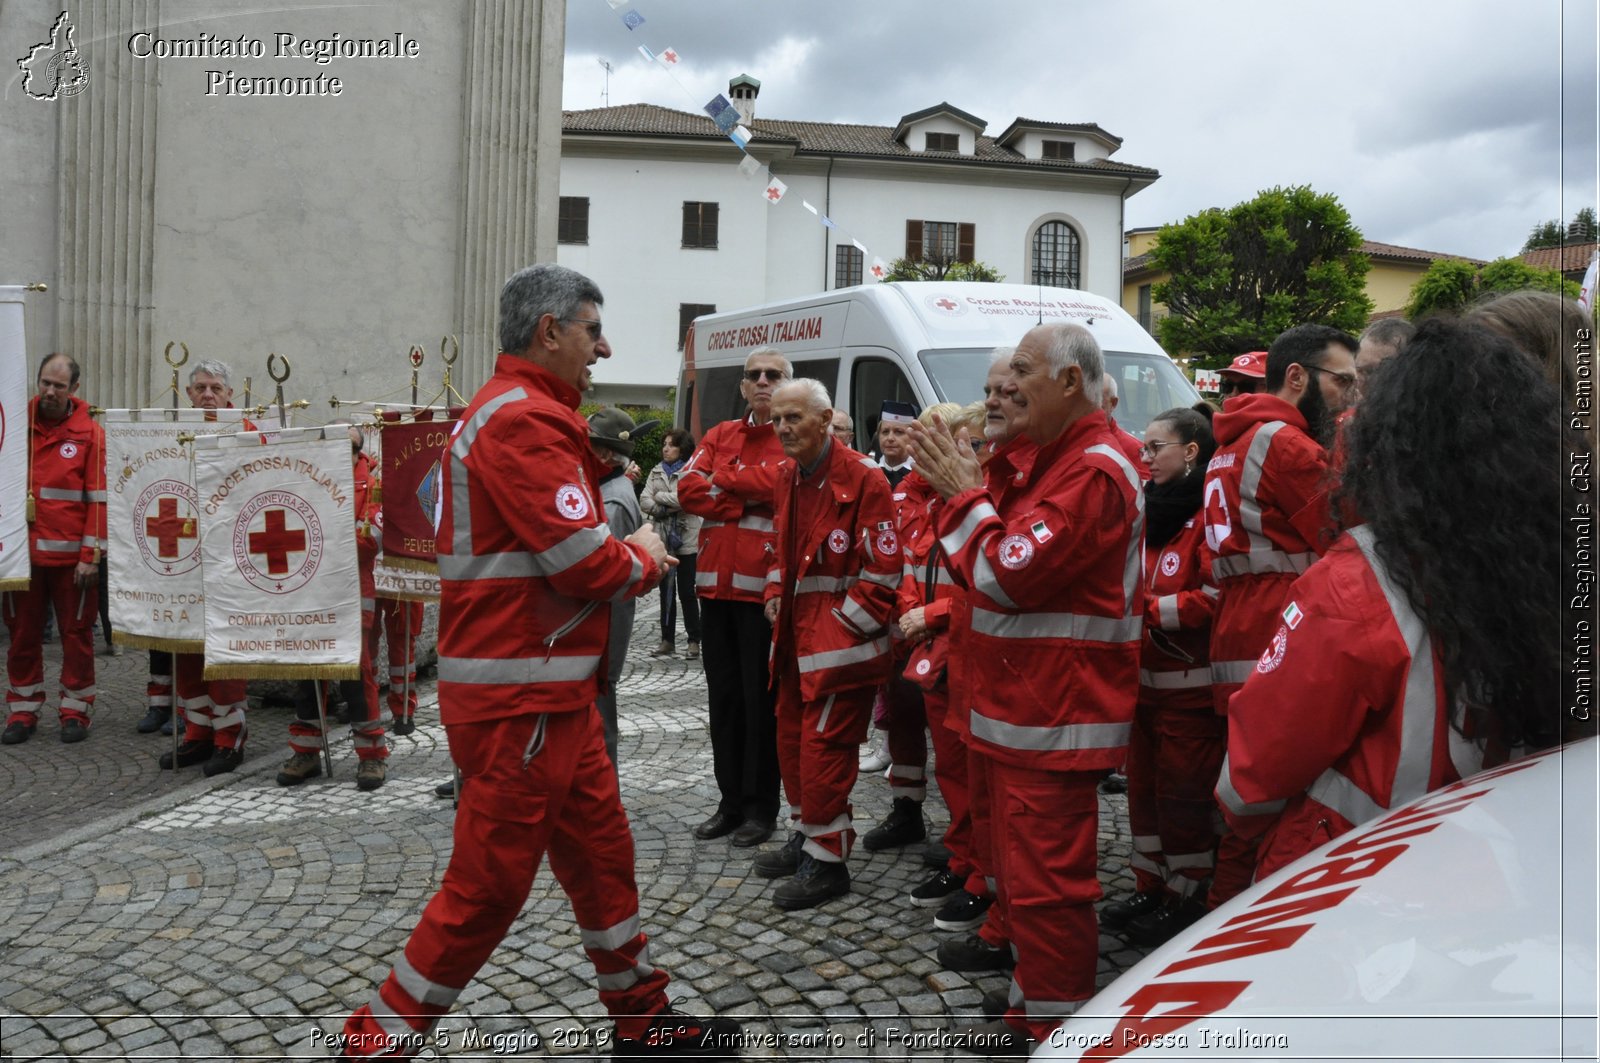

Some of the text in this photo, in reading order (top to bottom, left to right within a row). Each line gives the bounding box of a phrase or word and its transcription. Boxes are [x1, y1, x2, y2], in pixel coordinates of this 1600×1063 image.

[965, 296, 1010, 307] Croce
[1011, 298, 1056, 309] Rossa
[1058, 301, 1109, 313] Italiana
[707, 316, 823, 352] CROCE ROSSA ITALIANA
[113, 457, 145, 495] CRCE
[143, 447, 188, 464] ROSSA
[204, 456, 347, 516] CROCE ROSSA ITALIANA
[235, 493, 321, 581] CONVENZIONE DI GINEVRA 22 AGOSTO 1864
[116, 590, 165, 604] COMITATO
[228, 613, 337, 627] COMITATO LOCALE
[276, 628, 286, 638] DI
[228, 638, 337, 652] LIMONE PIEMONTE
